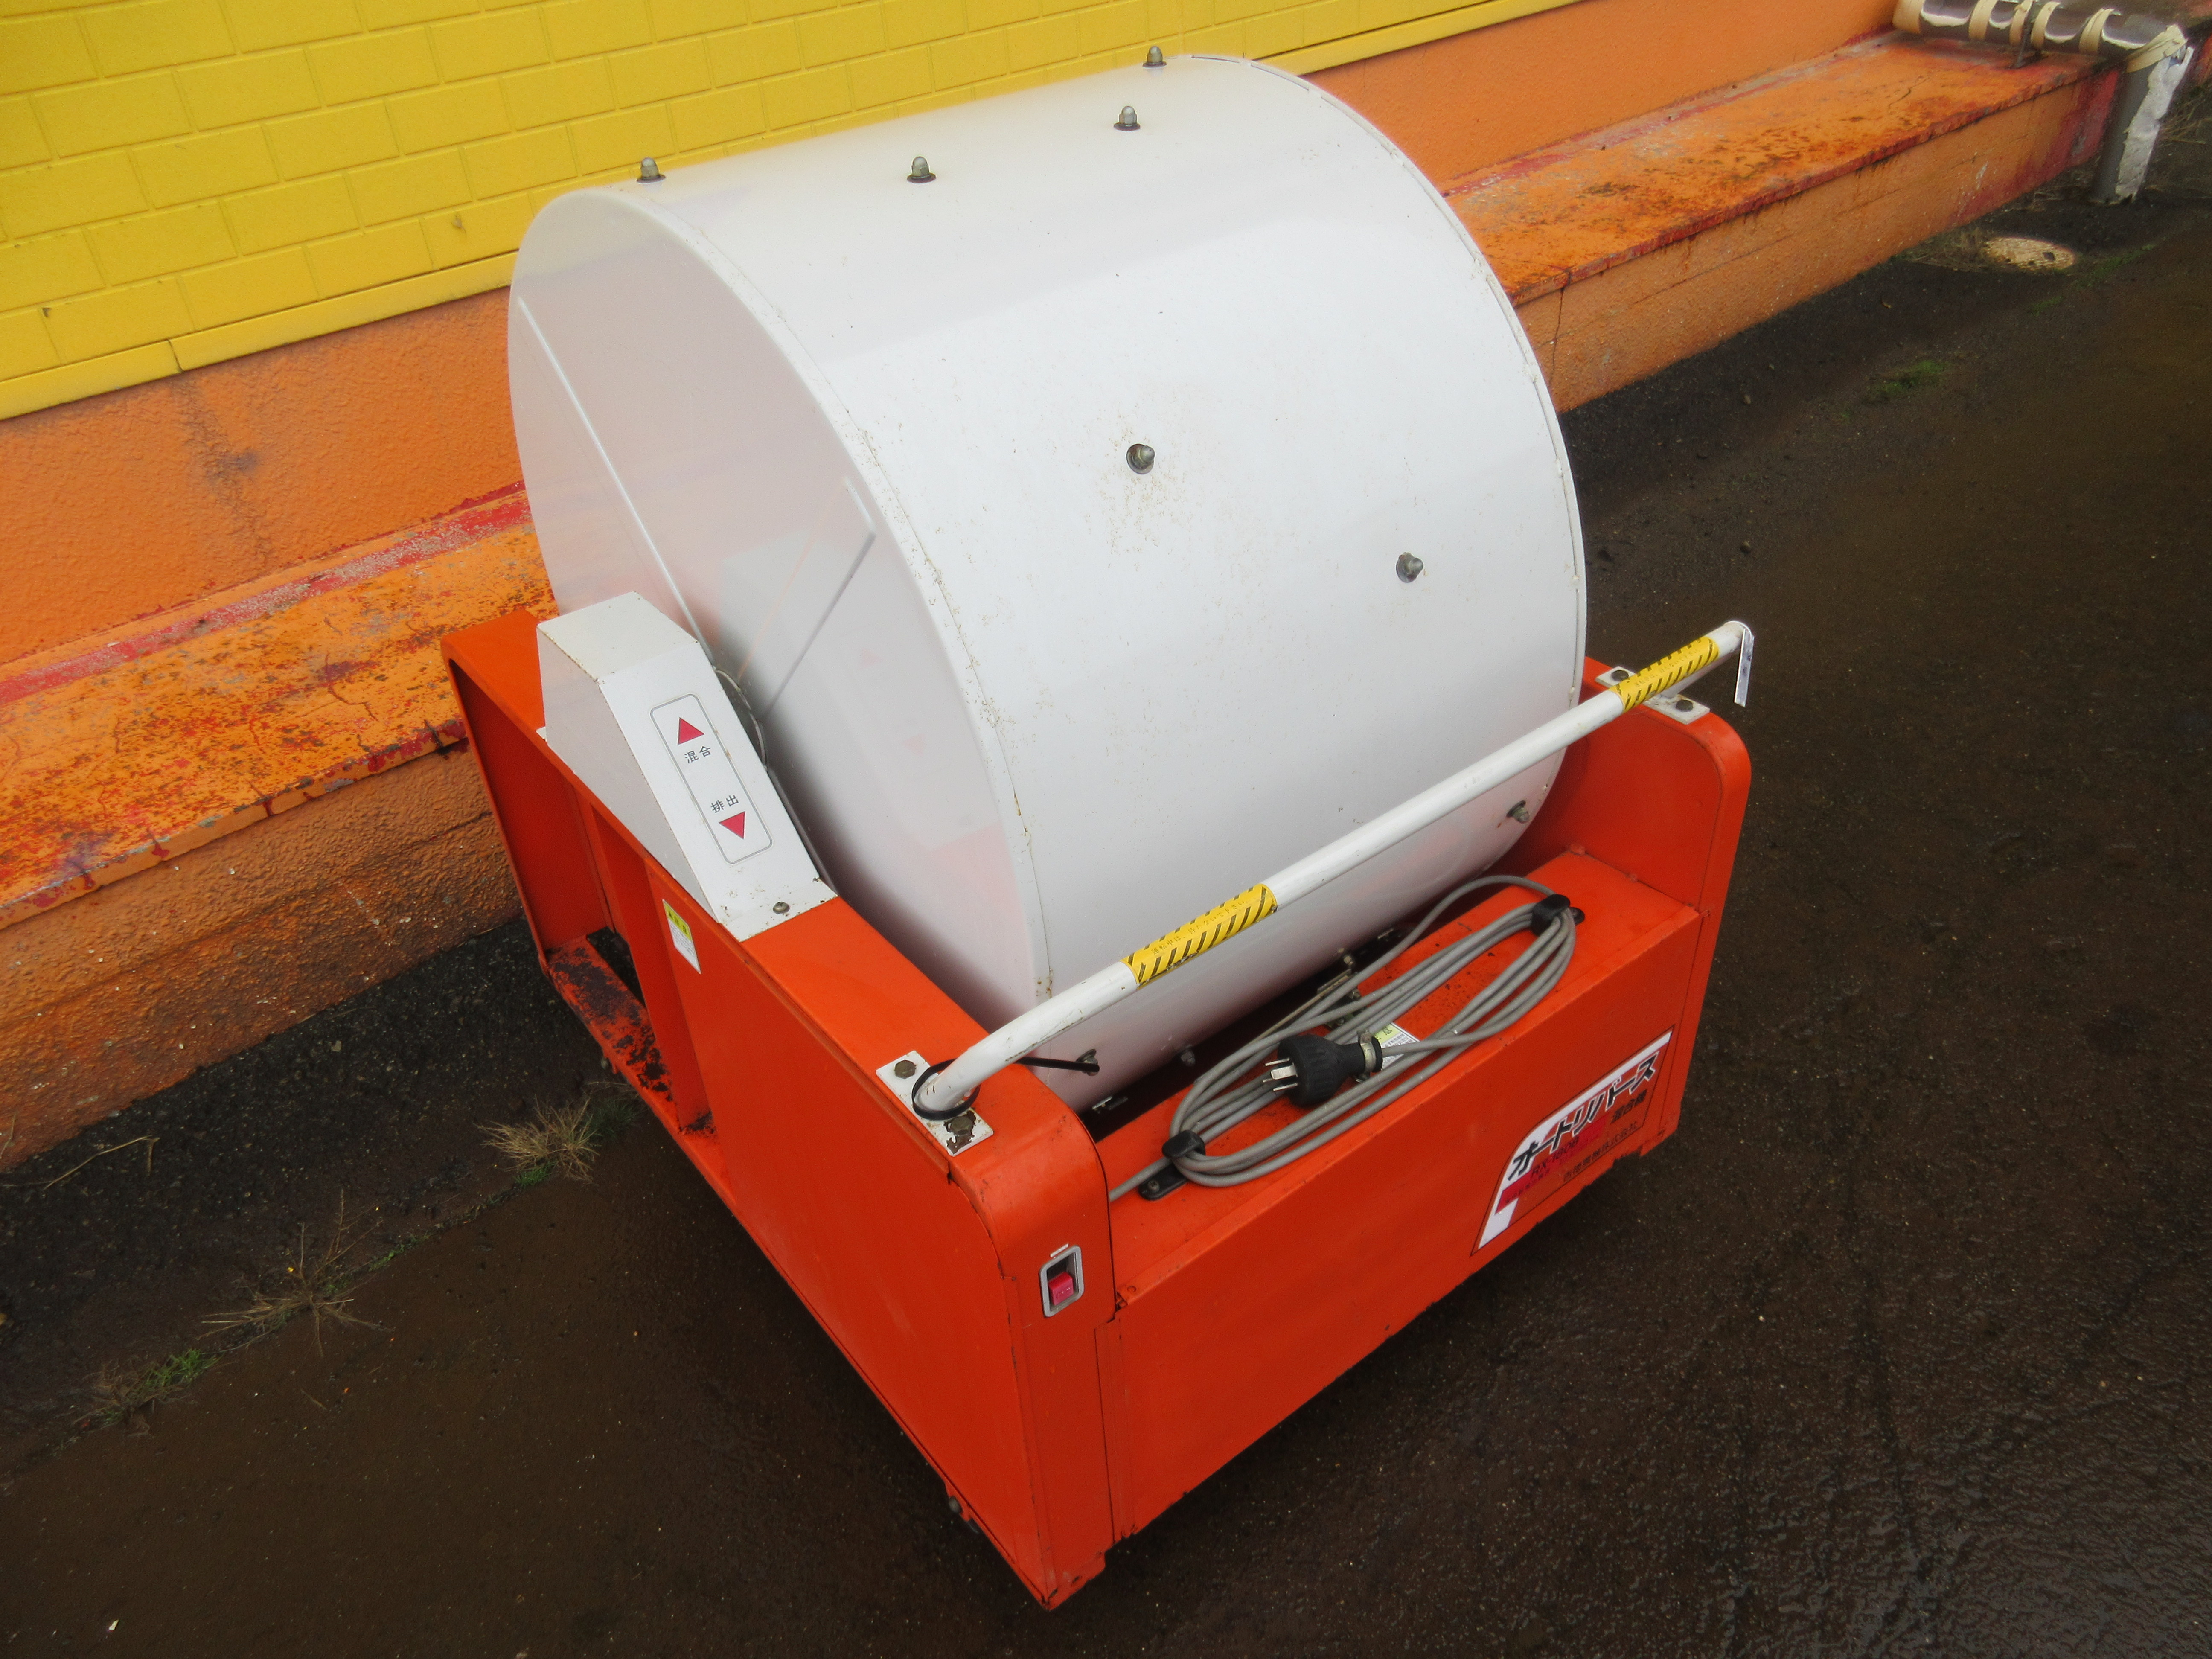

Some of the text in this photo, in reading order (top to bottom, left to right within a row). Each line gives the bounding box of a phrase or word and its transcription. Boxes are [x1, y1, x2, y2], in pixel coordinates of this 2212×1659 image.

[684, 746, 711, 764] 混合
[710, 795, 739, 813] 排出
[1508, 1051, 1659, 1181] オートリバース
